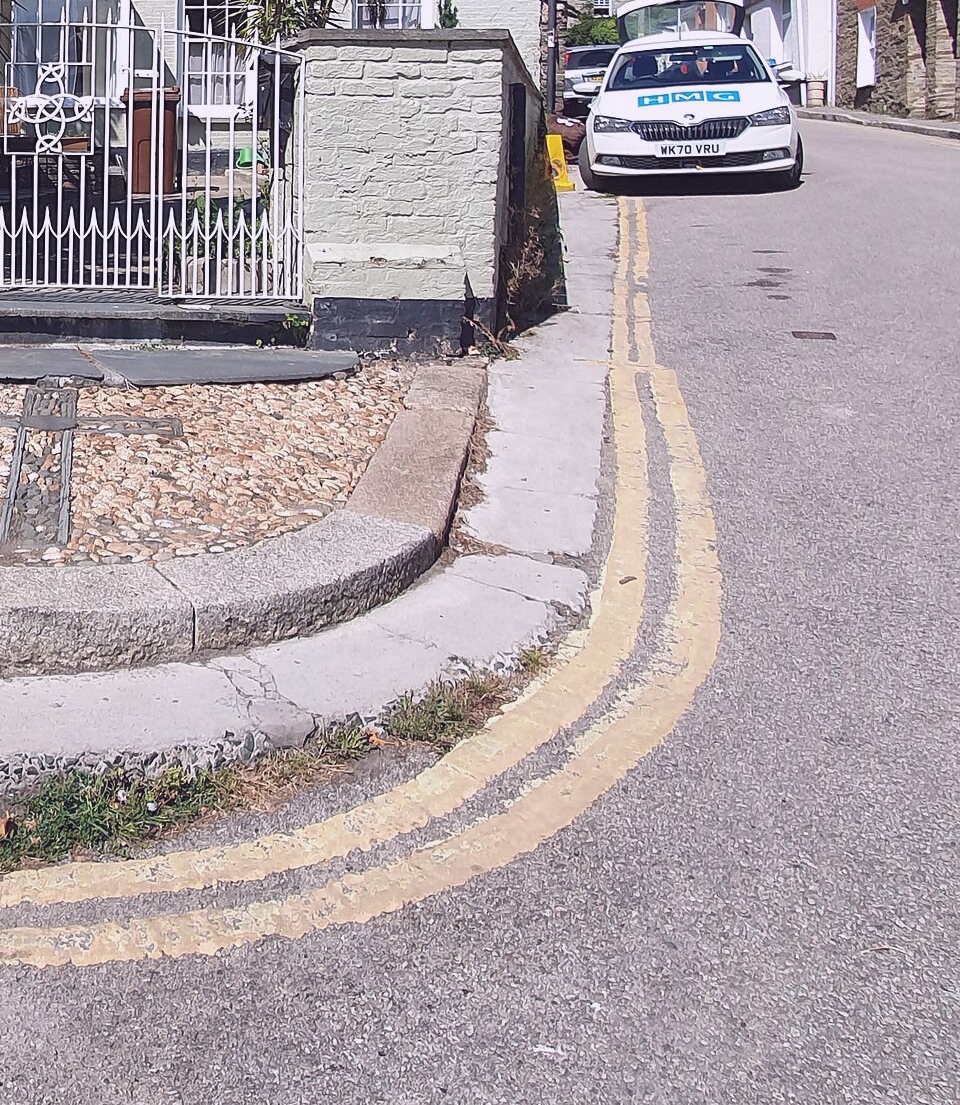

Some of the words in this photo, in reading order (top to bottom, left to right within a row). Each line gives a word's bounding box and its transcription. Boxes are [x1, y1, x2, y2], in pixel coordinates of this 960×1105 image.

[643, 92, 735, 105] HMG
[660, 145, 692, 155] WK70
[695, 144, 720, 154] VRU
